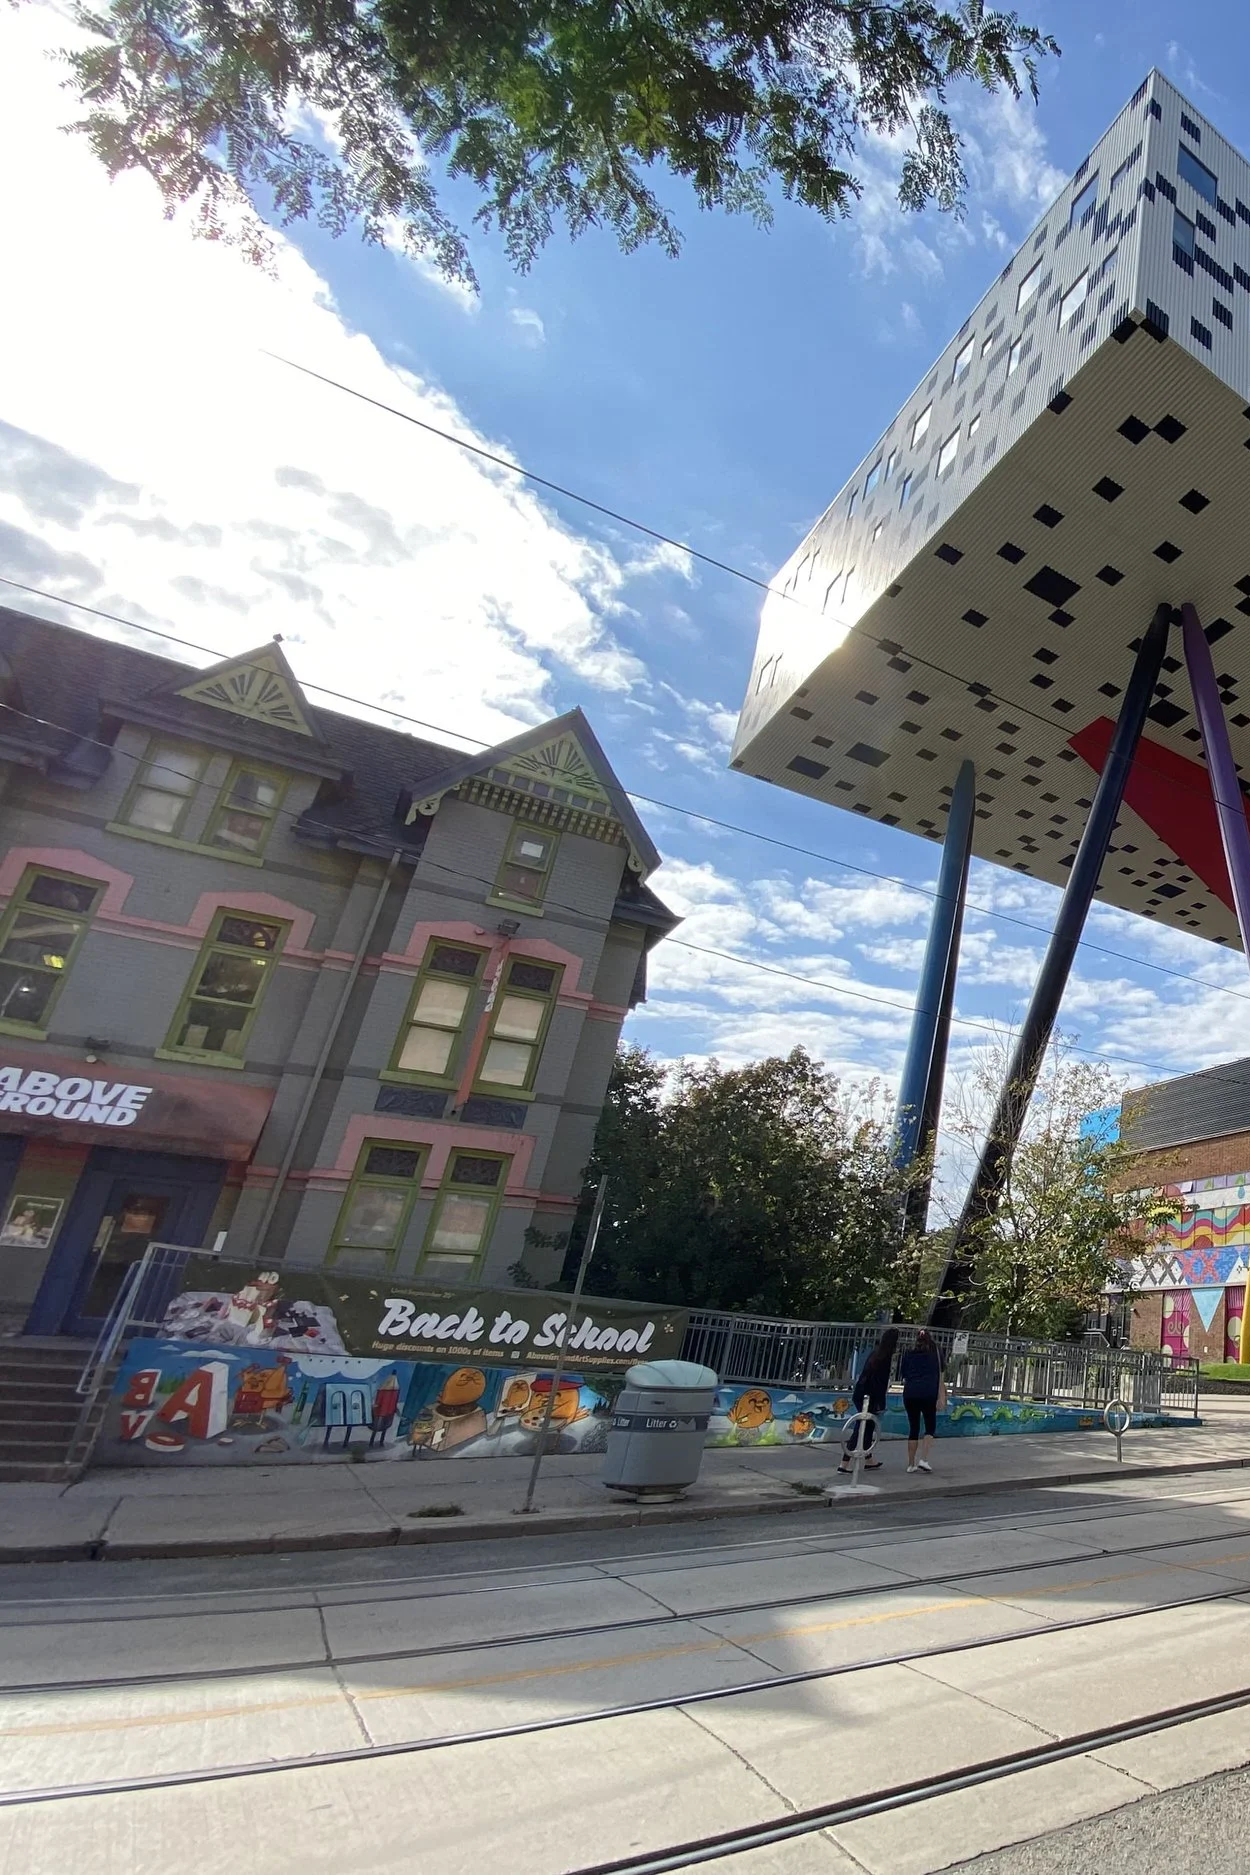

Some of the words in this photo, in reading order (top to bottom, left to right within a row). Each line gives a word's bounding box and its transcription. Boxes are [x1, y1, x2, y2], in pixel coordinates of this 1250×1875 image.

[0, 1066, 153, 1110] ABOVE
[0, 1090, 138, 1127] ROUND
[378, 1298, 485, 1342] Back
[489, 1310, 530, 1344] to
[533, 1312, 655, 1354] School
[371, 1340, 395, 1351] Huge
[396, 1342, 434, 1353] discounts
[435, 1346, 447, 1354] on
[448, 1345, 471, 1355] 1000s
[472, 1347, 482, 1356] of
[482, 1348, 504, 1358] items
[646, 1418, 667, 1428] Litter
